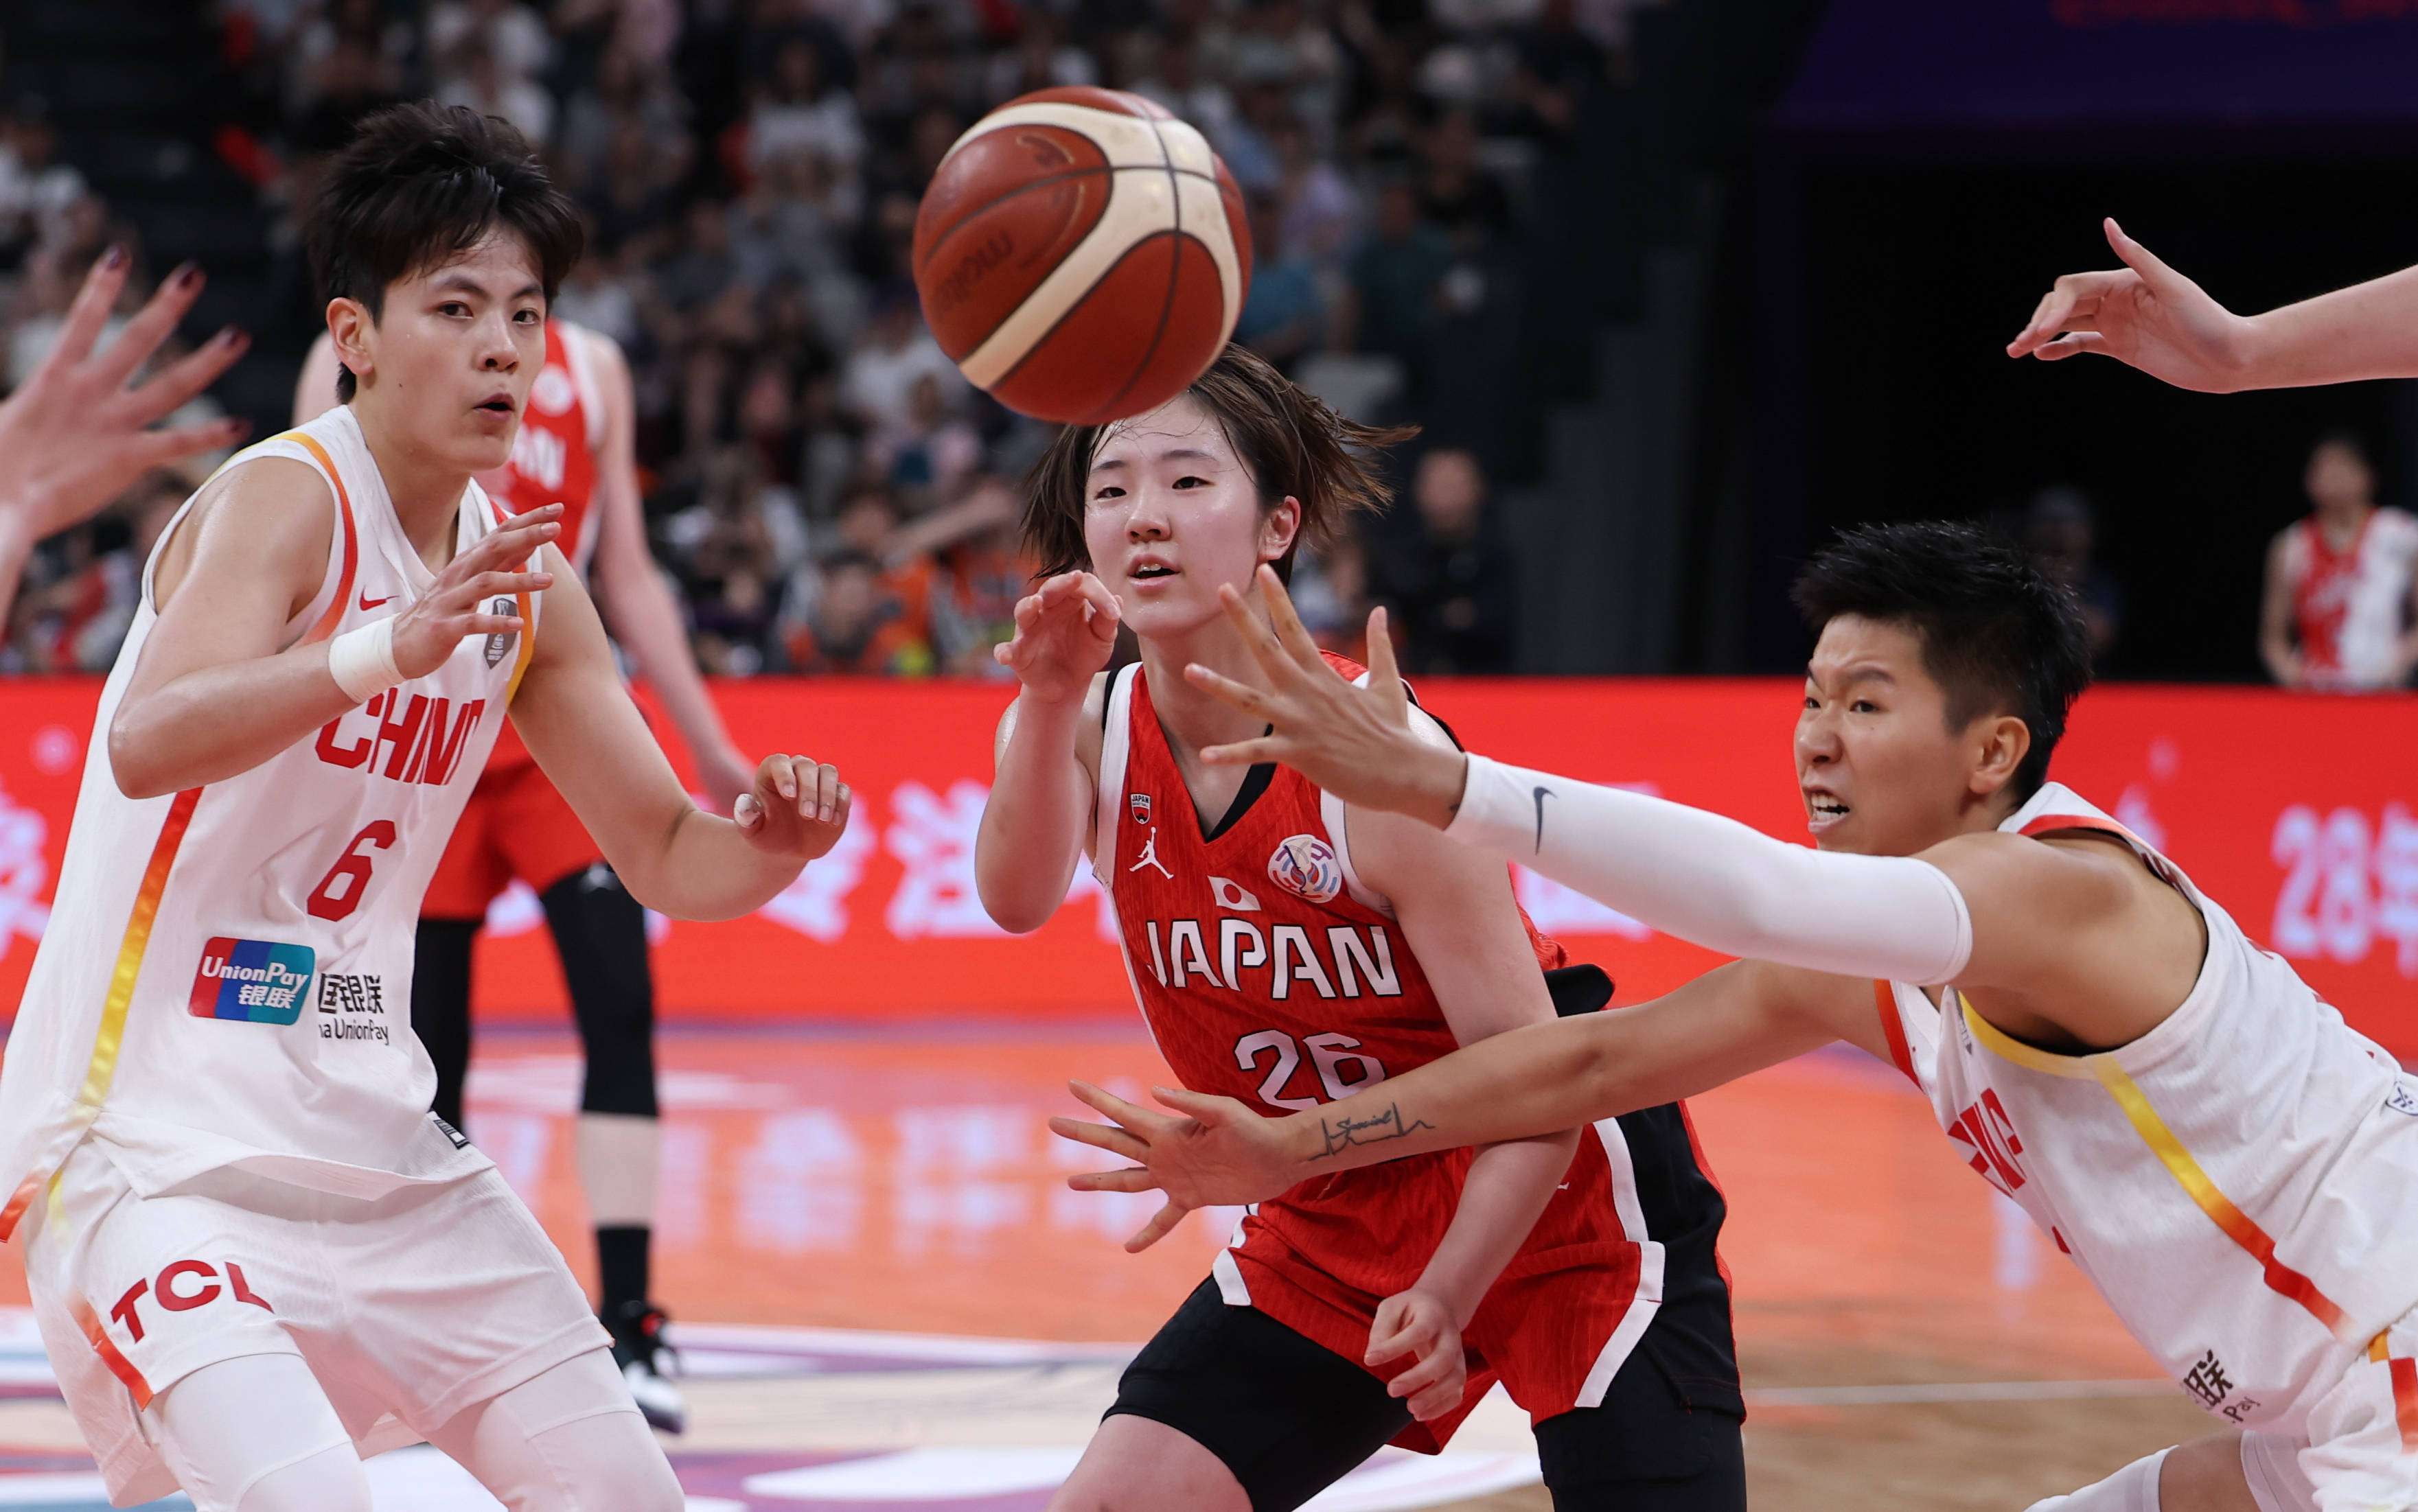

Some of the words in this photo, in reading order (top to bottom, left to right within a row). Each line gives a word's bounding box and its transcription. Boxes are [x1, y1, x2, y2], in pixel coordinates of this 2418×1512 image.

[307, 819, 397, 922] 6
[200, 956, 309, 994] UnionPay
[238, 984, 297, 1010] 银联
[1146, 918, 1402, 1000] JAPAN
[1234, 1029, 1387, 1111] 26
[111, 1259, 275, 1344] TCL
